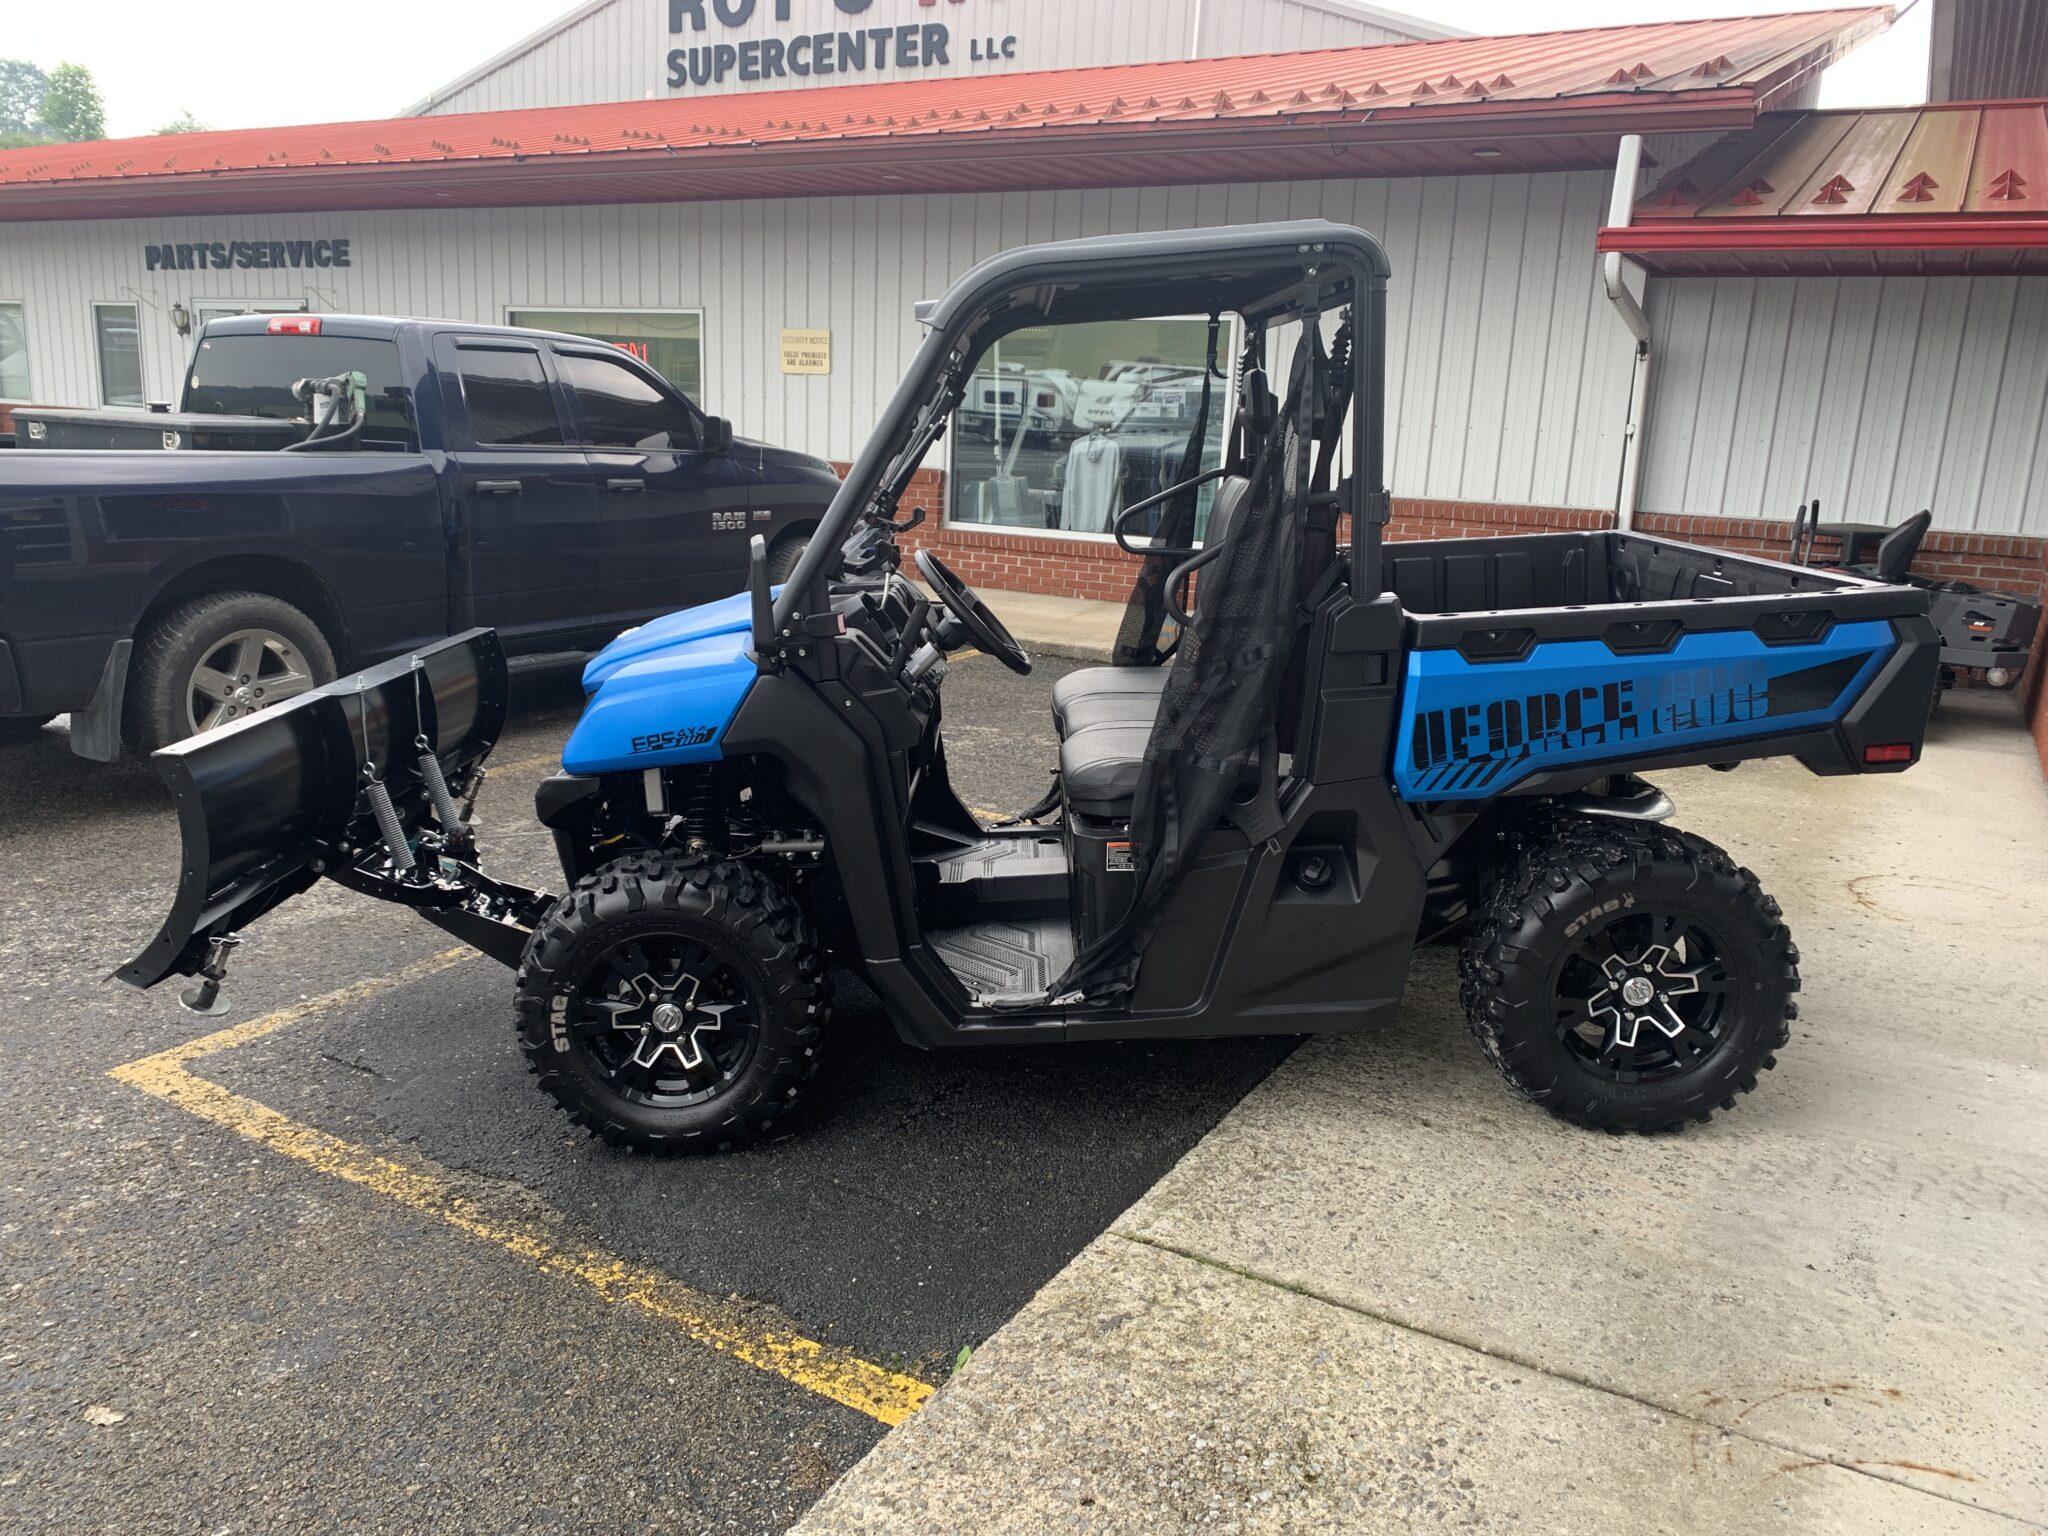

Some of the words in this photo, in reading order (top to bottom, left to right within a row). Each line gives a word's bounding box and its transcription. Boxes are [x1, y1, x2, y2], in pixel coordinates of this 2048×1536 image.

[666, 23, 950, 88] SUPERCENTER
[970, 35, 1016, 61] LLC
[145, 239, 350, 271] PARTS/SERVICE
[810, 336, 829, 344] NOTICE
[712, 512, 746, 521] RAM
[712, 521, 746, 530] 1500
[632, 731, 678, 752] EPS
[1564, 899, 1620, 938] STAG
[550, 995, 570, 1053] STAG
